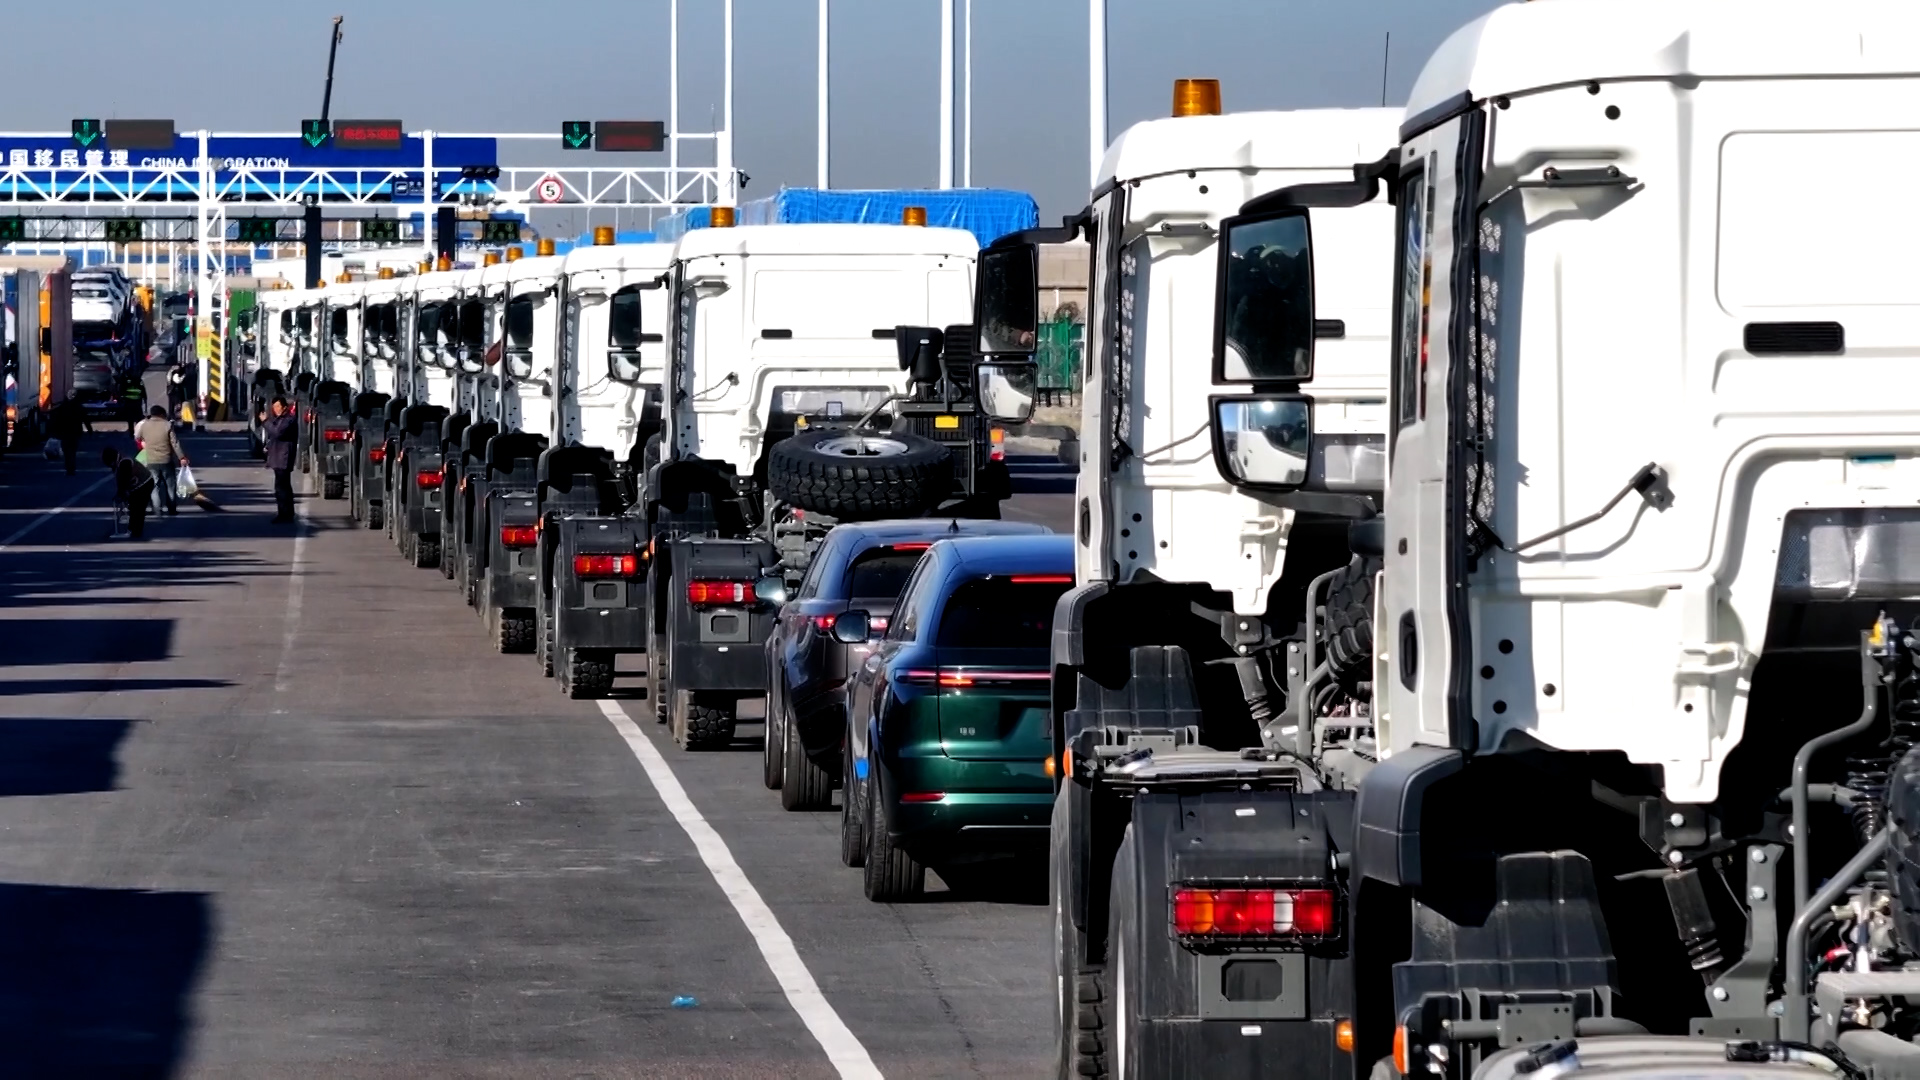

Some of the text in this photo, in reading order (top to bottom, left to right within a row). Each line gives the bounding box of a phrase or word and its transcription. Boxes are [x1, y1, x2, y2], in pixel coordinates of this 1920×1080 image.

[0, 149, 129, 167] 国移民管理
[141, 157, 186, 168] CHINA
[546, 185, 555, 197] 5
